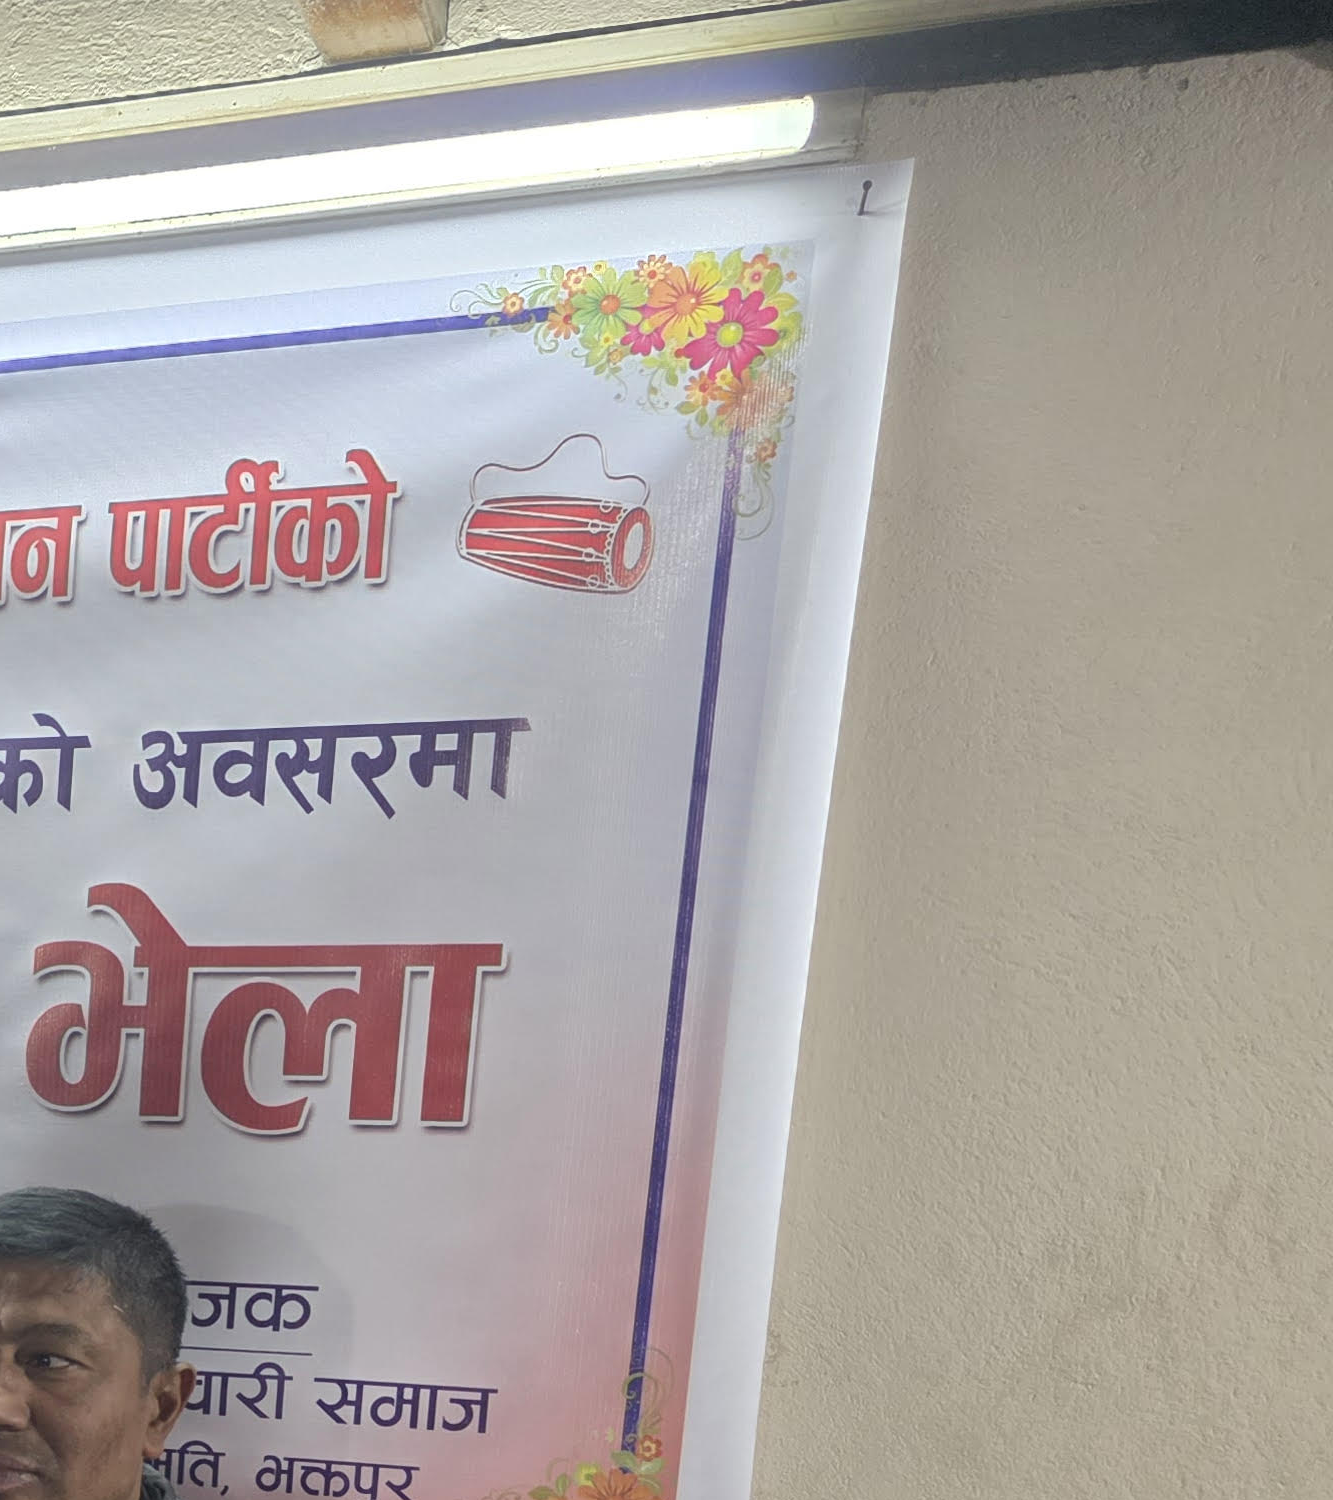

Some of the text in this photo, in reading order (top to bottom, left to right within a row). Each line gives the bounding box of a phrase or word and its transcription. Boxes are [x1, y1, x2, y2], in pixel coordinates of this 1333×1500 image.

[108, 447, 400, 597] पार्टीको
[131, 716, 533, 820] अवसरमा
[24, 880, 507, 1136] भेला
[186, 1280, 320, 1332] जक
[313, 1377, 499, 1434] समाज
